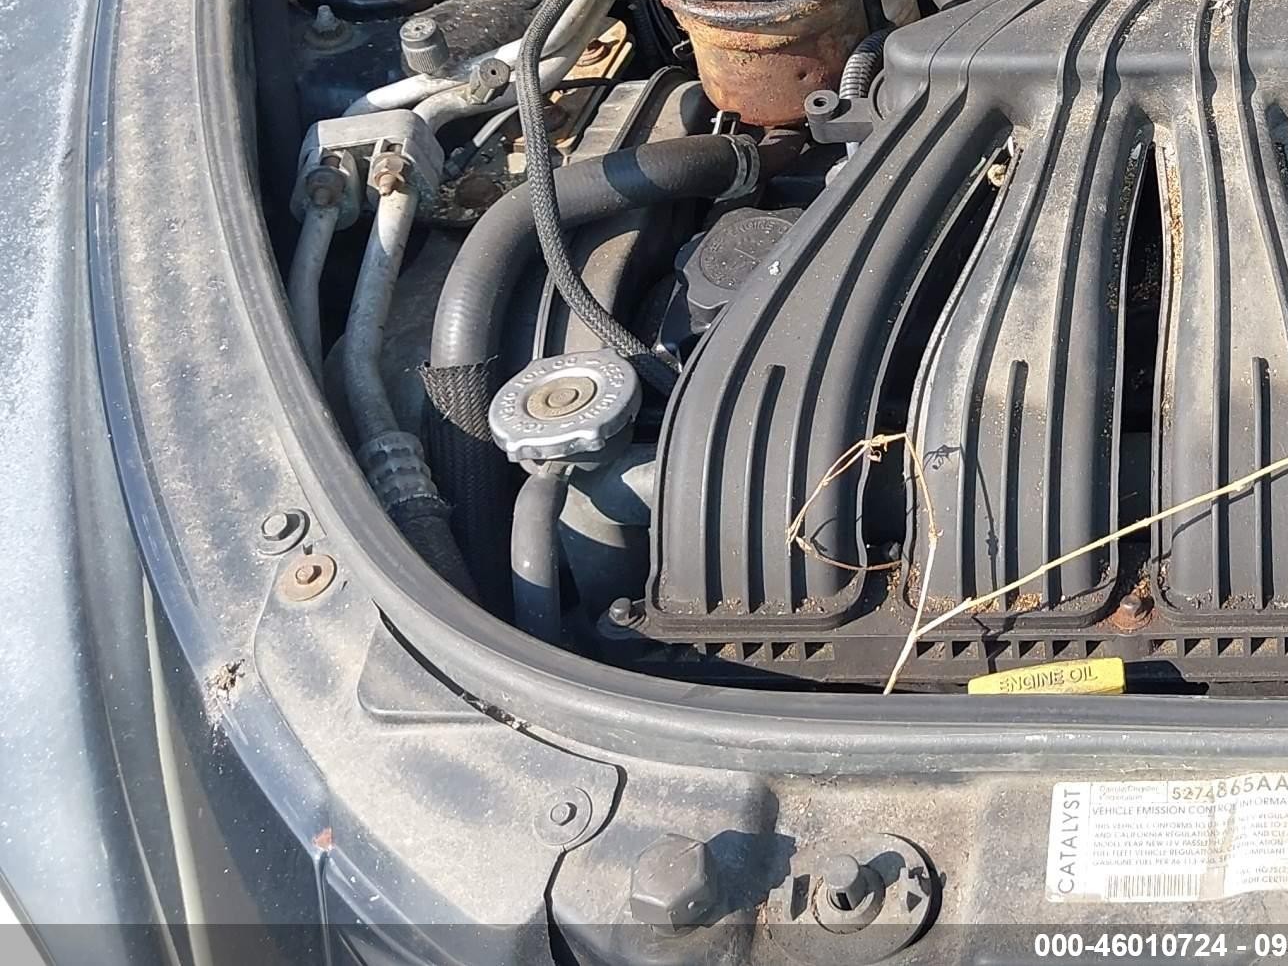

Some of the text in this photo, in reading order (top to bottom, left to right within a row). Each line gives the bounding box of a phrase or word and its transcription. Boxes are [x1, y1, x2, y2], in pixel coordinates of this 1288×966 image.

[1000, 664, 1098, 692] ENGINE OIL
[1091, 805, 1134, 817] VEHICLE
[1136, 804, 1186, 816] EMISSION
[1188, 801, 1237, 816] CONTROL
[1057, 788, 1082, 894] CATALYST
